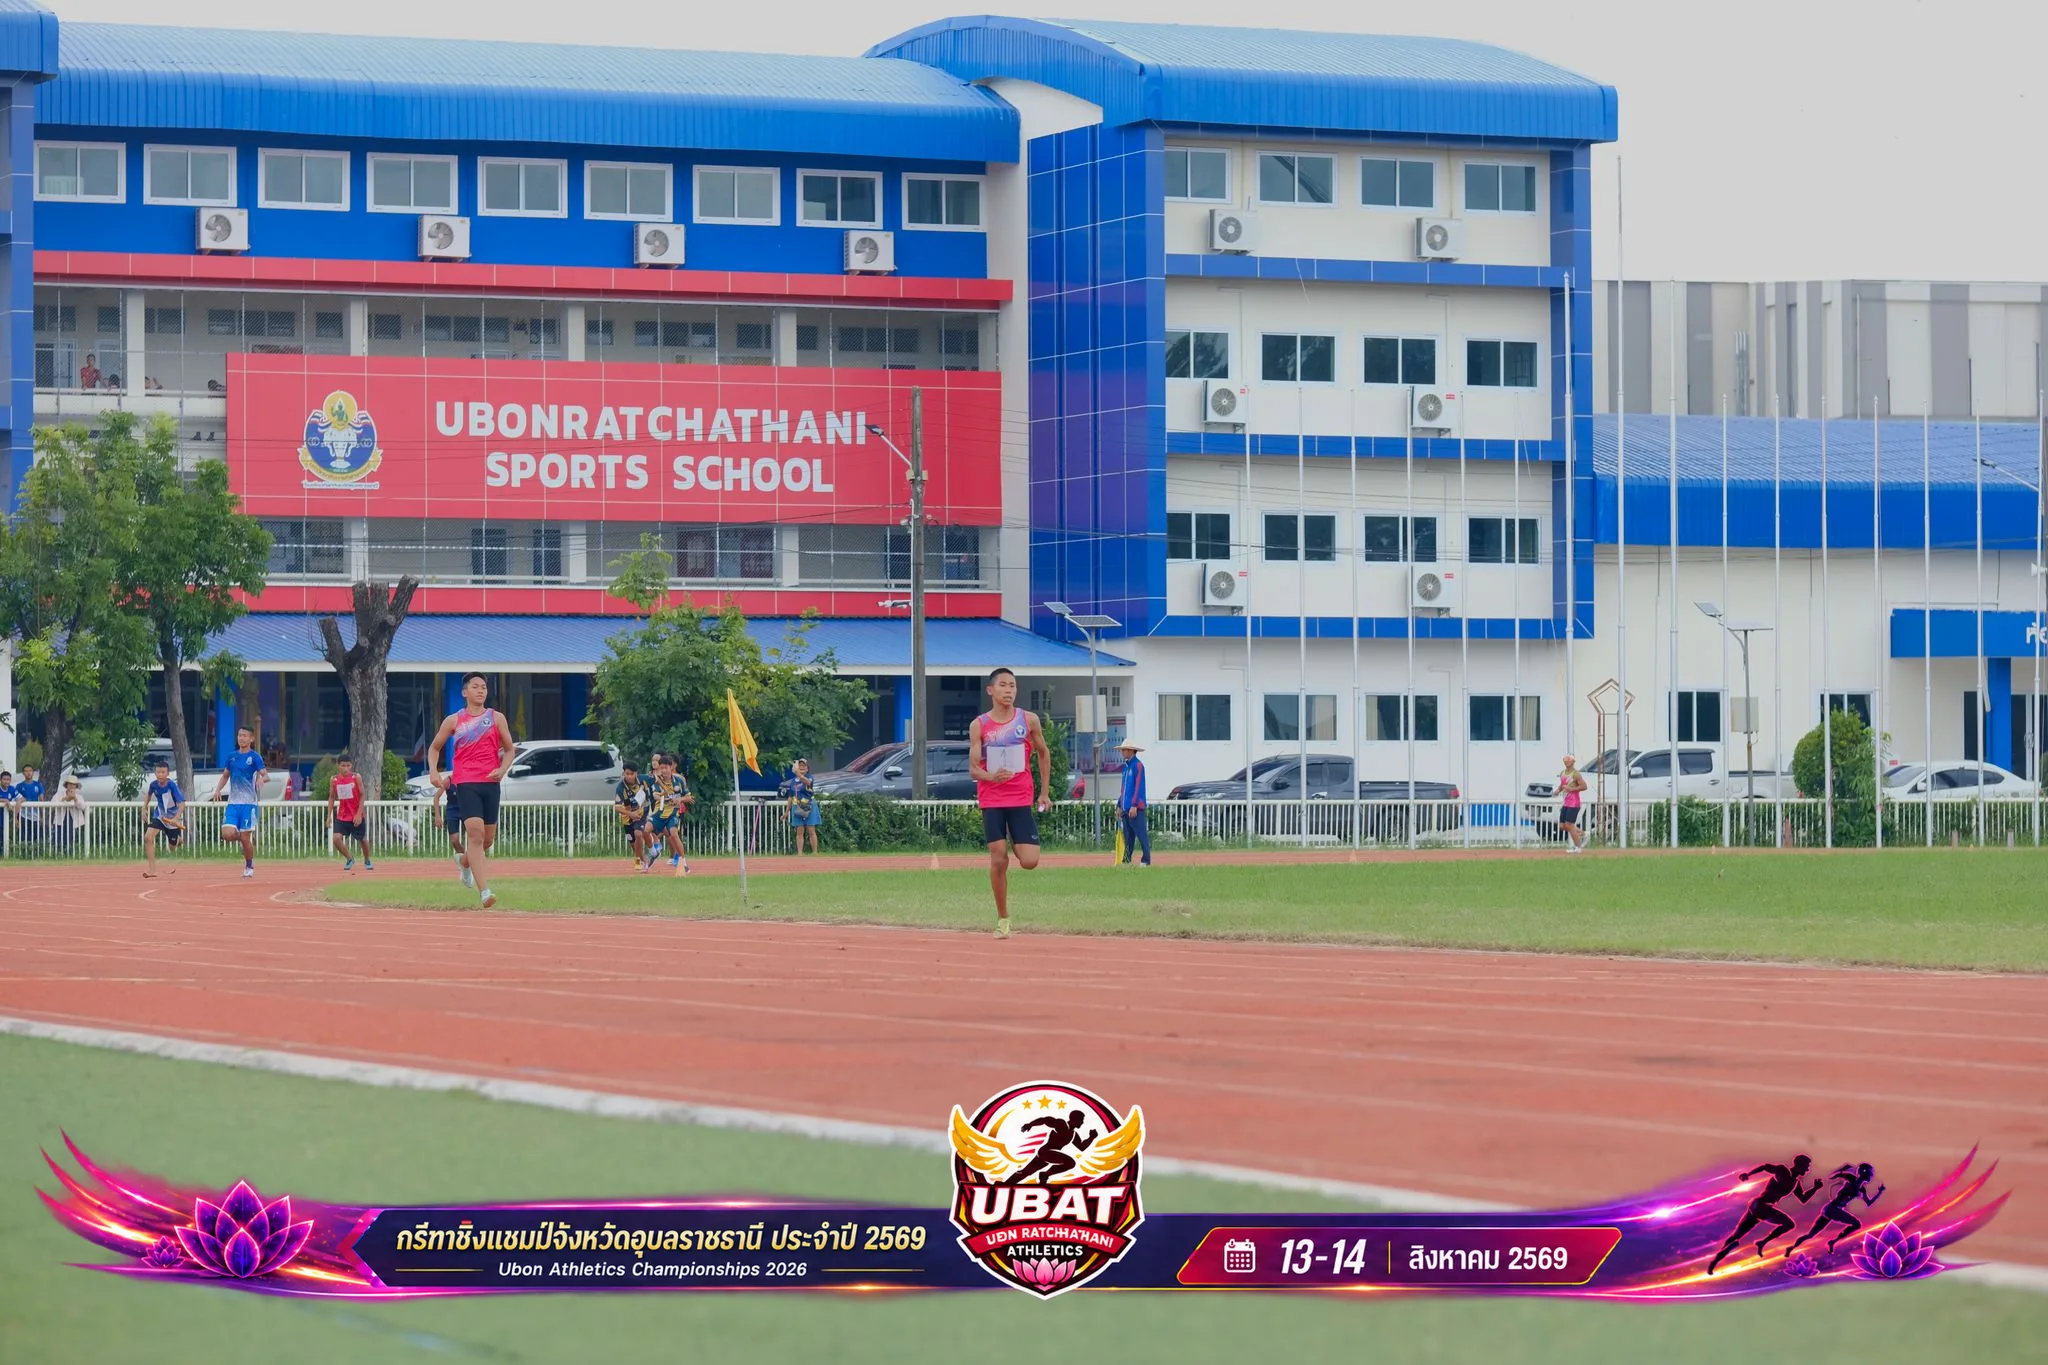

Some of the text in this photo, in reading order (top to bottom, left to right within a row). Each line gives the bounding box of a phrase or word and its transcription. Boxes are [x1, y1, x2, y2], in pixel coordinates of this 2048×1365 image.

[436, 401, 866, 445] UBONRATCHATHANI
[486, 452, 834, 493] SPORTS SCHOOL
